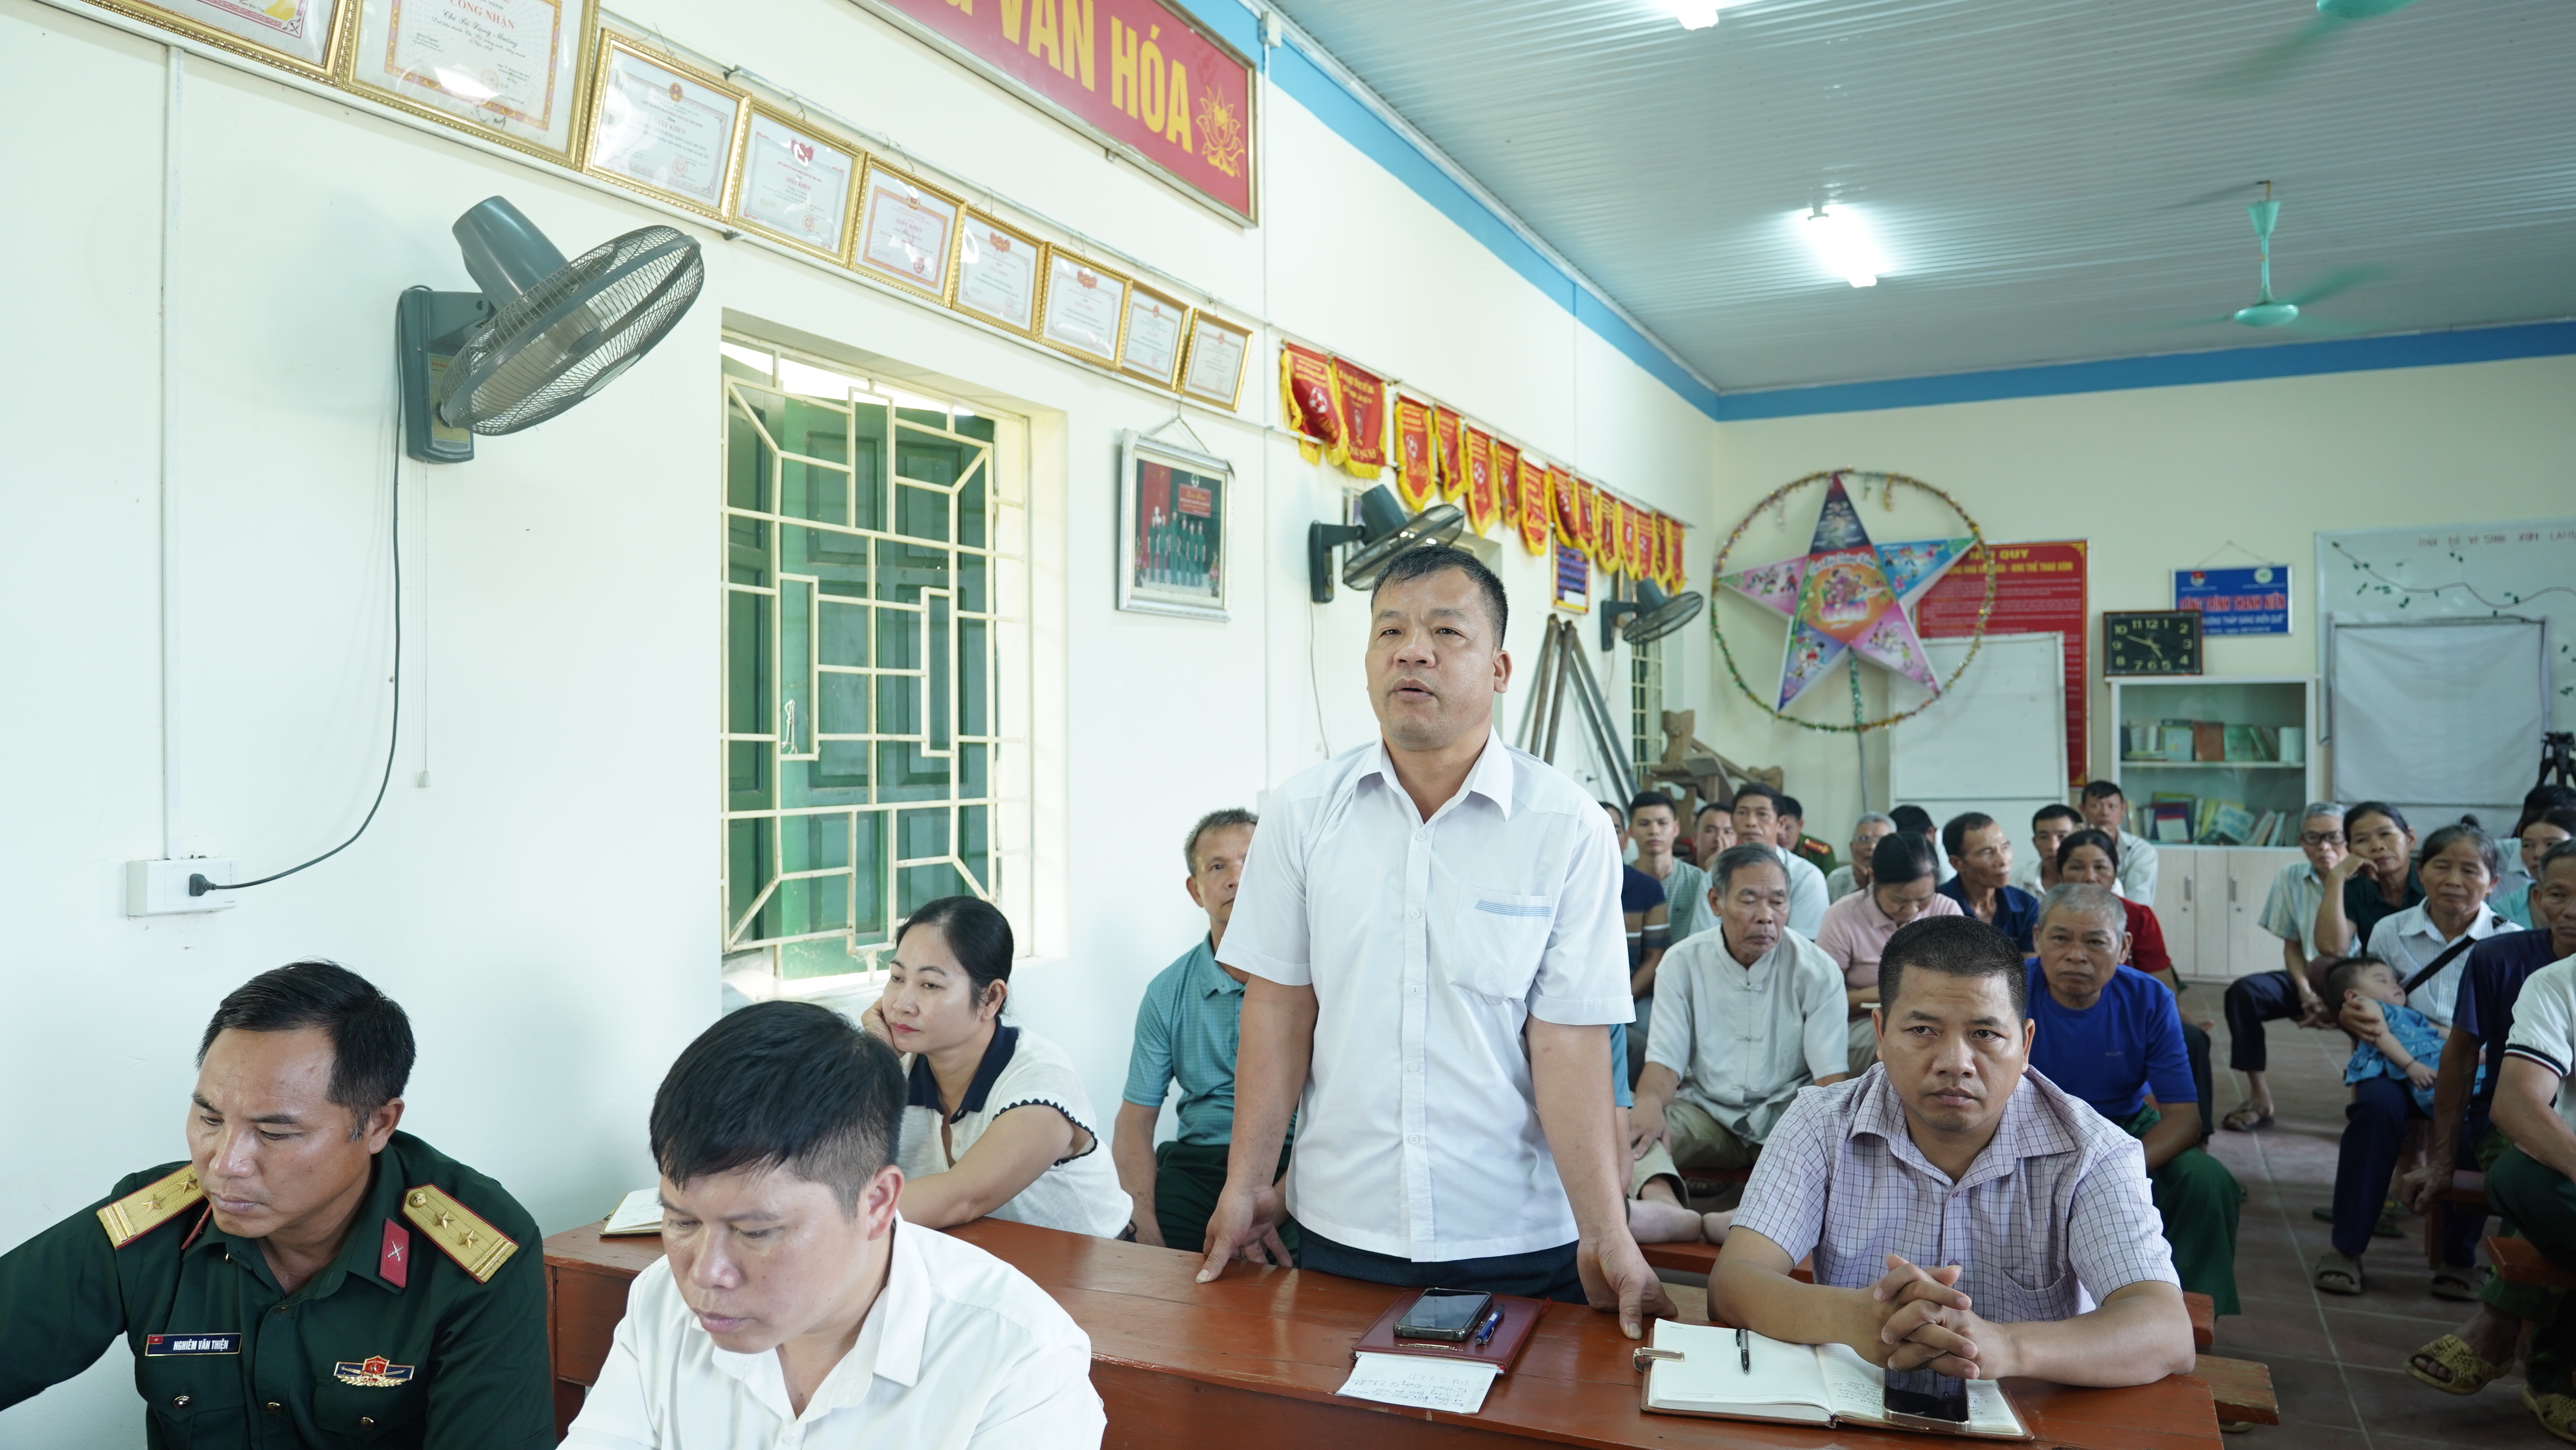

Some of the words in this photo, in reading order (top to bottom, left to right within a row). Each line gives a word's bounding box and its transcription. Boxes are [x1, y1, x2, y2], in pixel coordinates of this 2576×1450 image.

[485, 10, 516, 29] NHẬN
[1111, 16, 1193, 154] HÓA
[1999, 549, 2030, 559] QUY
[2132, 619, 2143, 630] 11
[2145, 618, 2158, 629] 12
[2163, 618, 2169, 629] 1
[2179, 623, 2189, 634] 2
[2114, 624, 2128, 635] 10
[2112, 640, 2122, 651] 9
[2183, 639, 2192, 650] 3
[2116, 655, 2126, 667] 8
[2179, 654, 2189, 665] 4
[2134, 660, 2144, 671] 7
[2147, 660, 2158, 671] 6
[2161, 660, 2172, 671] 5
[173, 1339, 197, 1351] NGHIÊM
[198, 1339, 211, 1350] VĂN
[211, 1338, 229, 1351] THIỆN
